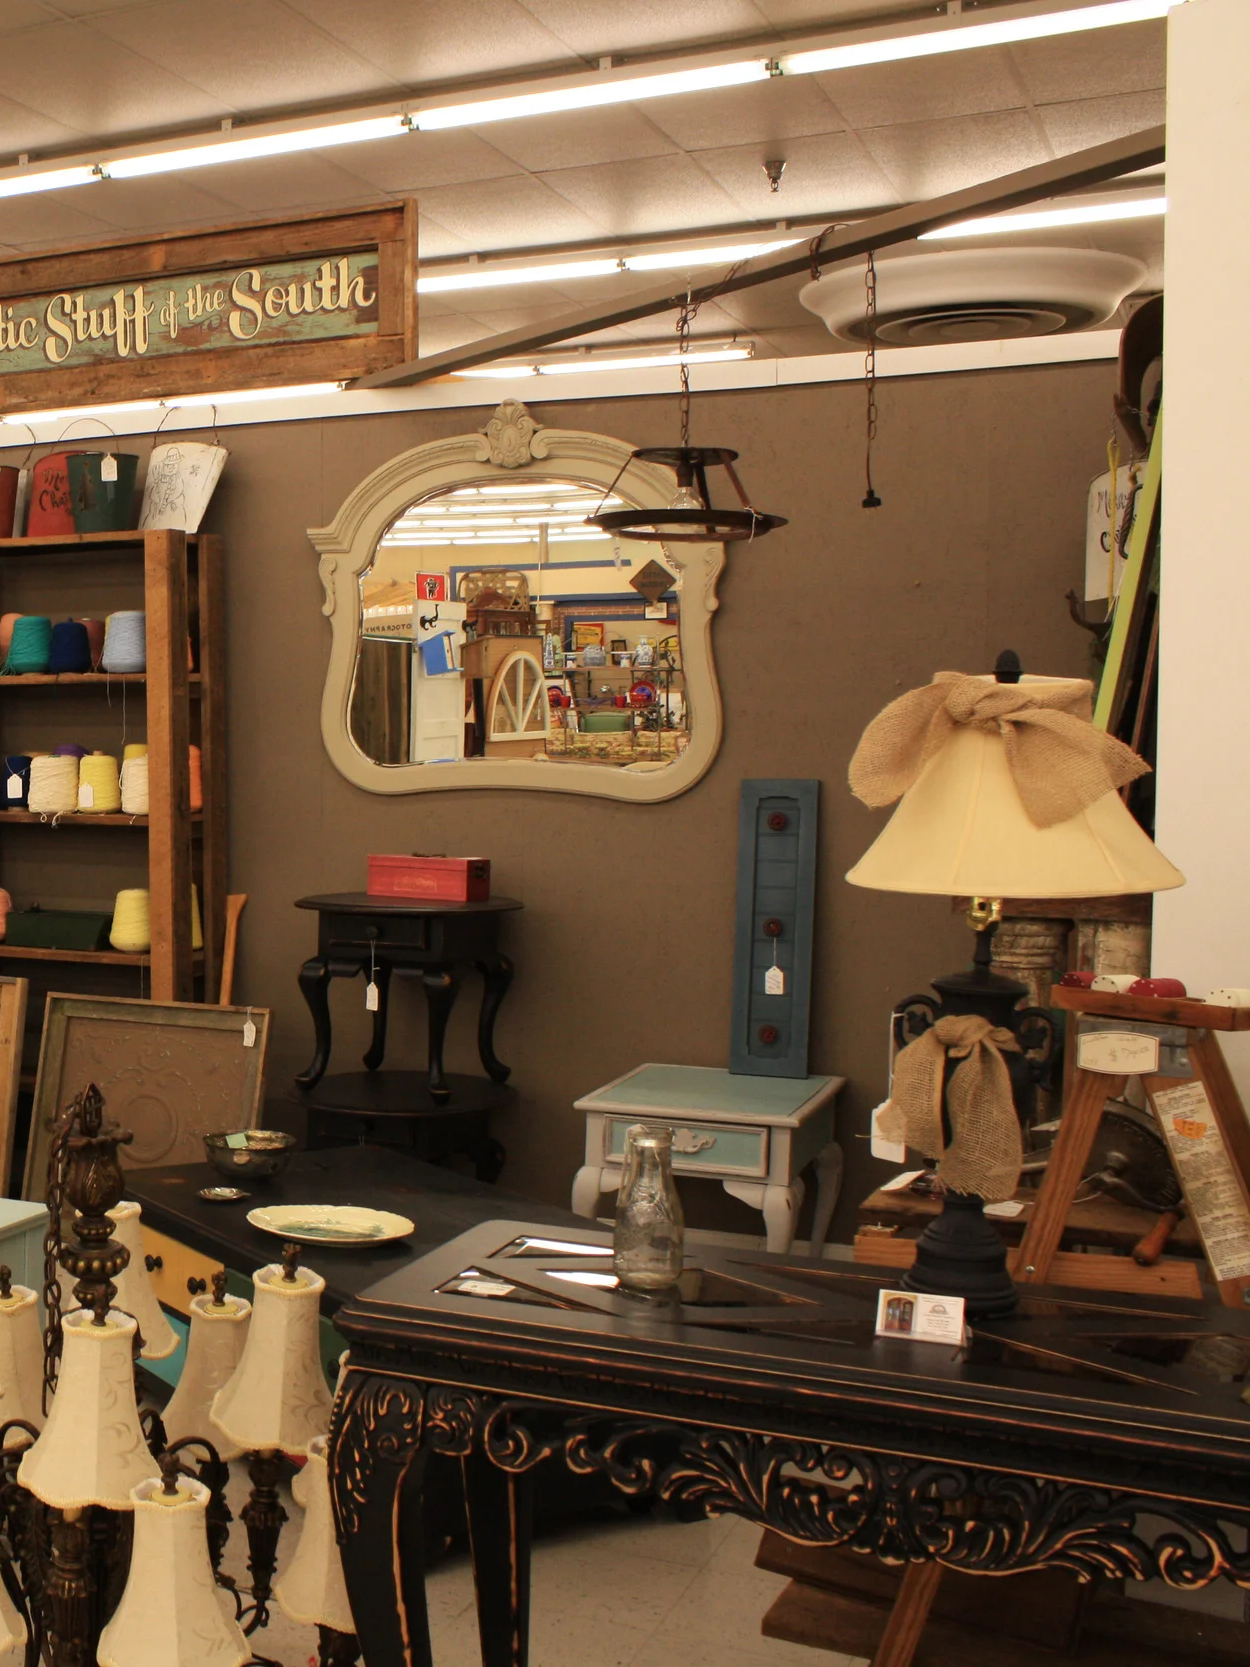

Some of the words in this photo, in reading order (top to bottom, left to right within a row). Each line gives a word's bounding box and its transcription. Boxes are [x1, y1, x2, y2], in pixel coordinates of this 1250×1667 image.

[44, 285, 155, 364] Stuff
[159, 295, 182, 339] of
[184, 283, 226, 322] the
[228, 256, 376, 340] South
